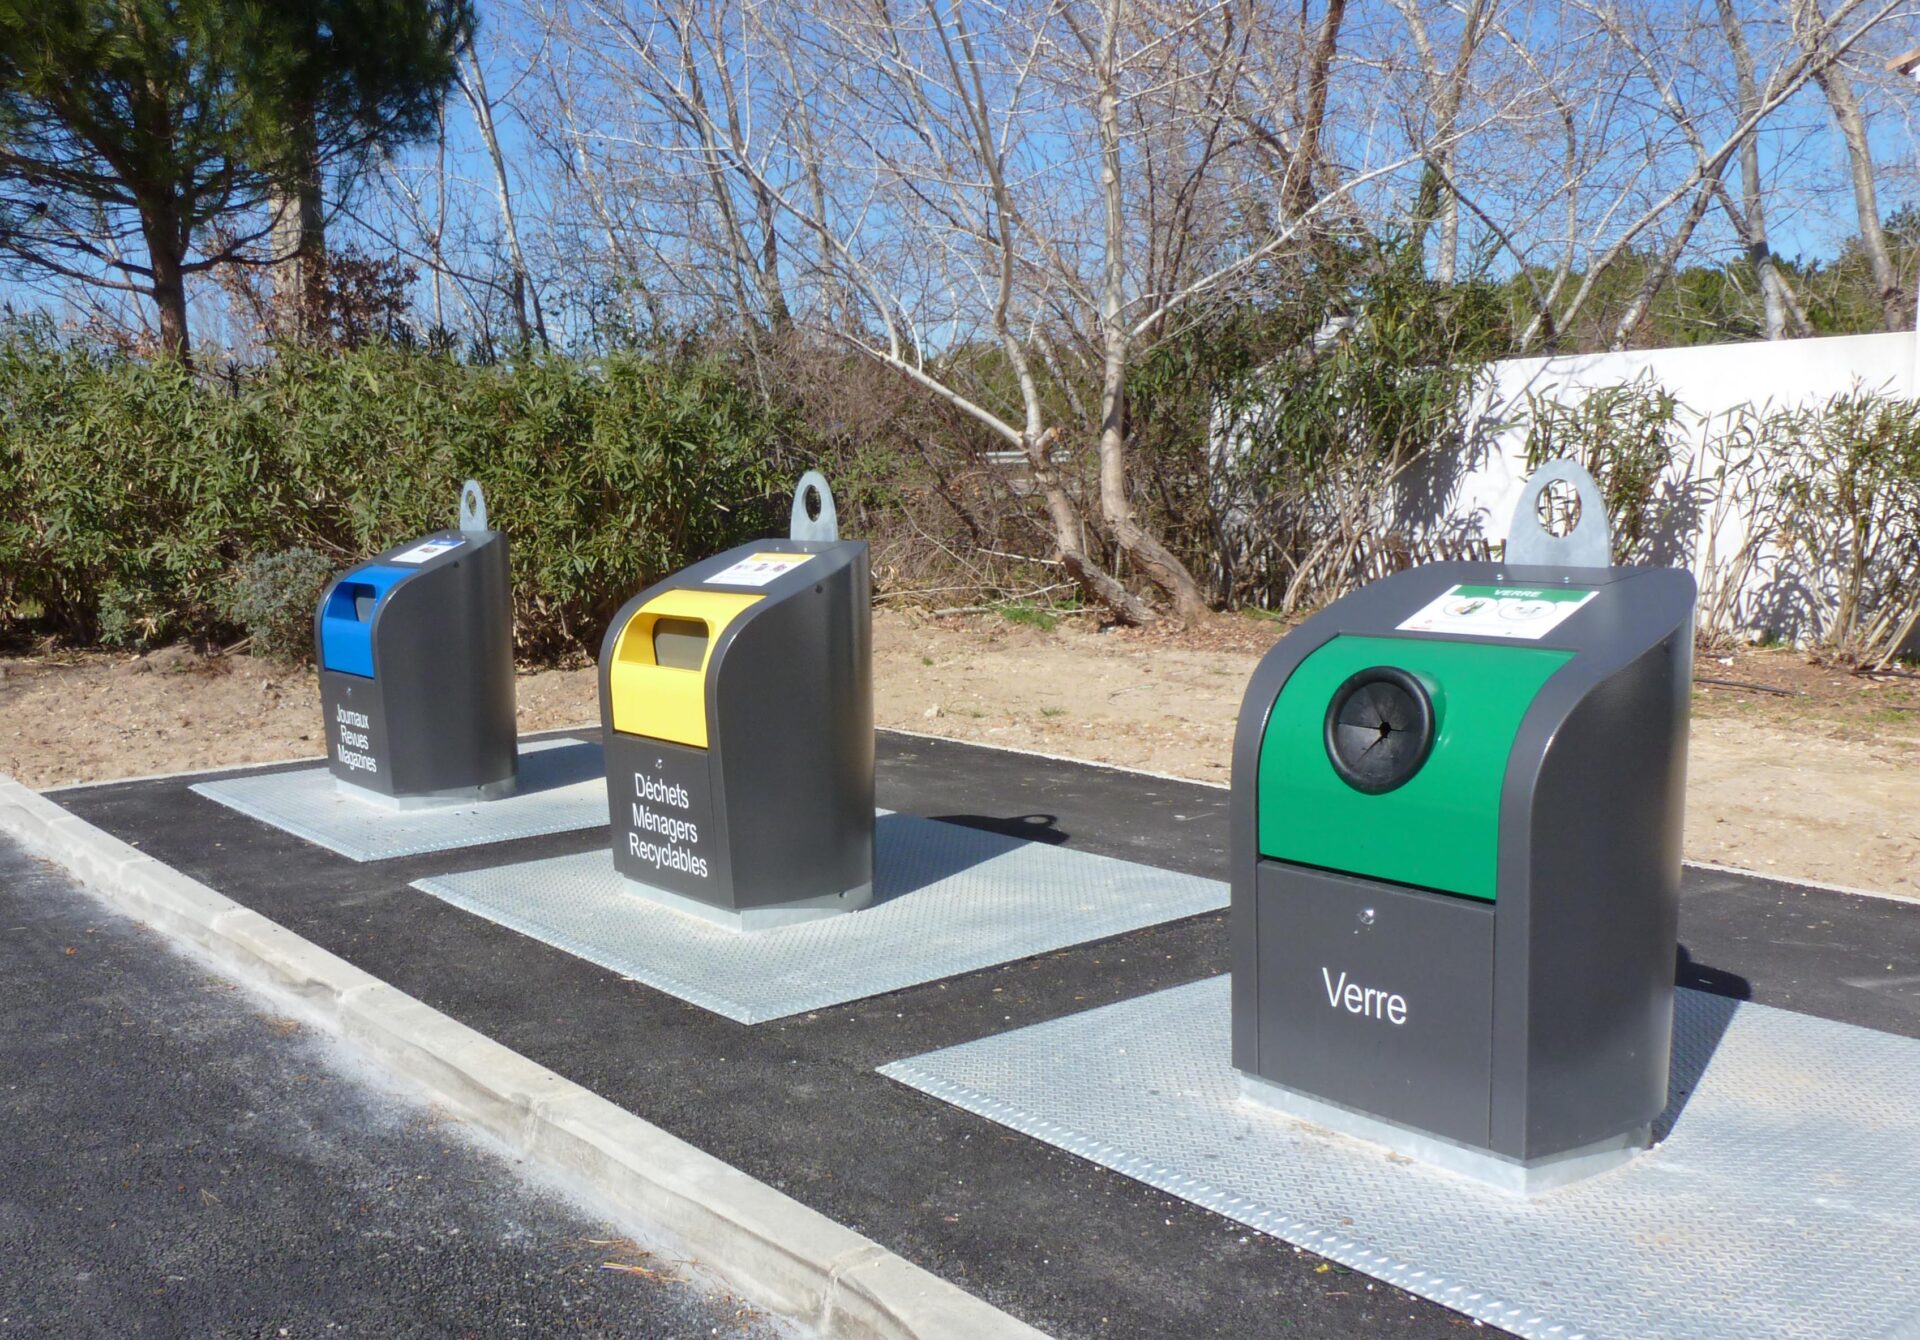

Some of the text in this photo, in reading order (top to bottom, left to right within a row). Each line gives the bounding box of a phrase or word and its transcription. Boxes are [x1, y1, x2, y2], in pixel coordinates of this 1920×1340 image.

[1494, 589, 1543, 598] VERRE
[336, 703, 370, 730] Journaux
[340, 724, 369, 750] Revues
[337, 743, 377, 773] Magazines
[635, 772, 689, 809] Déchets
[632, 802, 698, 843] Ménagers
[628, 832, 708, 878] Recyclables
[1322, 967, 1407, 1025] Verre
